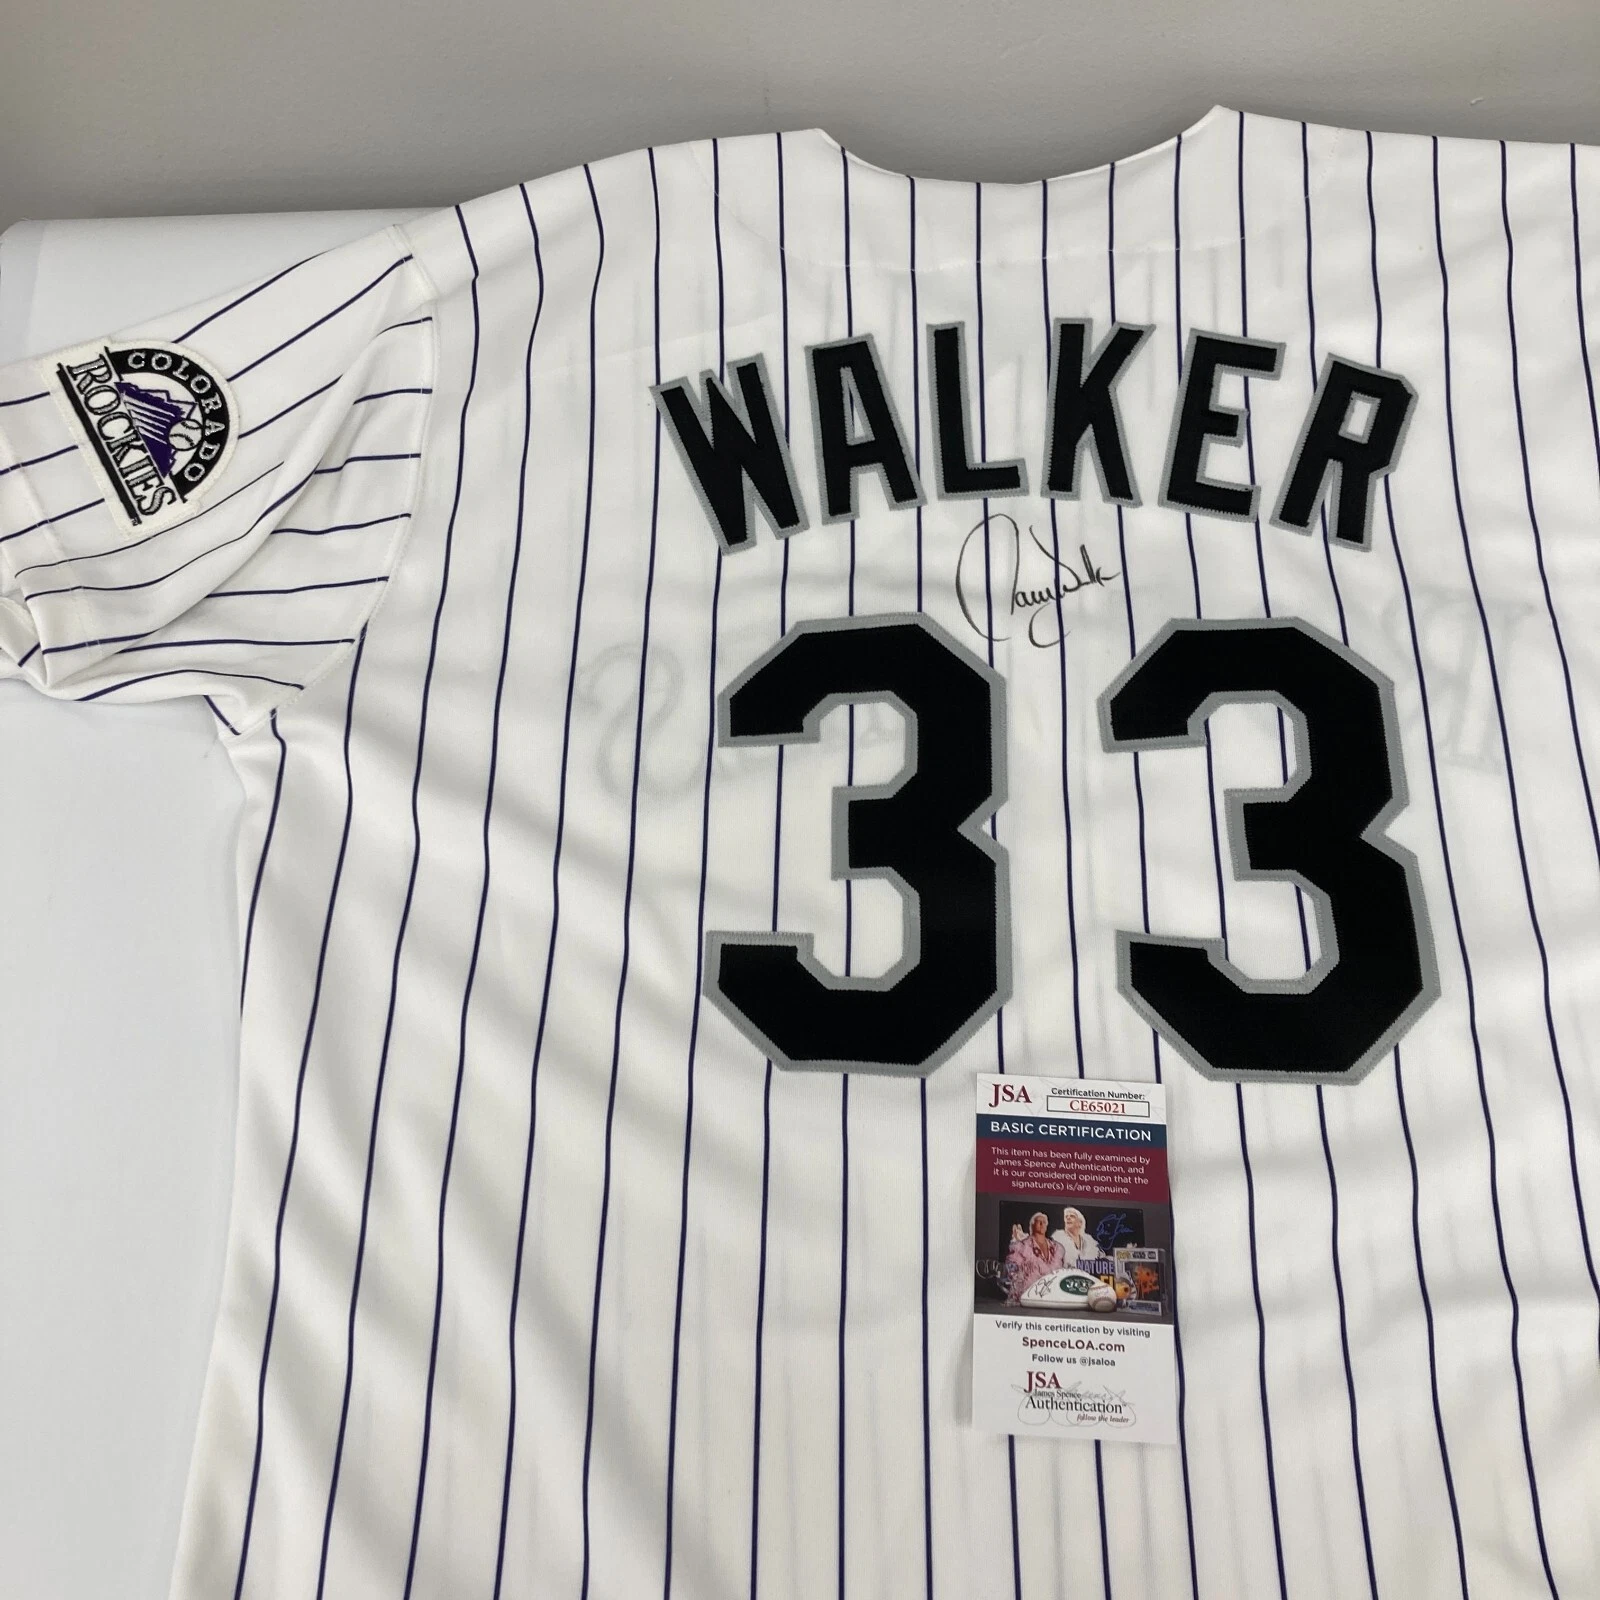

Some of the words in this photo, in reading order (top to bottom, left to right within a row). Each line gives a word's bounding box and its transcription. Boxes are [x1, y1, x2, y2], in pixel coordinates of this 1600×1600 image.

[127, 351, 226, 483] COLORADO
[67, 353, 178, 516] ROCKIES
[650, 317, 1419, 553] WALKER
[704, 612, 1441, 1084] 33
[989, 1084, 1032, 1108] JSA
[1051, 1087, 1105, 1098] Certification
[1107, 1091, 1145, 1100] Number:
[1069, 1100, 1126, 1114] CE65021
[991, 1121, 1034, 1134] BASIC
[1039, 1124, 1151, 1141] CERTIFICATION
[991, 1147, 1009, 1156] This
[1011, 1148, 1030, 1157] item
[1033, 1149, 1048, 1157] has
[1050, 1150, 1072, 1158] been
[1074, 1151, 1093, 1161] fully
[1095, 1152, 1137, 1162] examined
[1140, 1156, 1150, 1165] by
[994, 1158, 1022, 1167] James
[1024, 1160, 1056, 1169] Spence
[1059, 1161, 1125, 1172] Authentication,
[1127, 1165, 1144, 1174] and
[1028, 1170, 1076, 1180] considered
[1079, 1174, 1112, 1184] opinion
[1114, 1175, 1133, 1183] that
[1134, 1176, 1149, 1184] the
[1011, 1180, 1064, 1190] signature(s)
[1066, 1182, 1092, 1192] is/are
[1094, 1184, 1130, 1195] genuine.
[1076, 1259, 1114, 1274] NATURE
[996, 1320, 1023, 1331] Verify
[1025, 1321, 1042, 1331] this
[1044, 1323, 1100, 1333] certification
[1103, 1326, 1115, 1336] by
[1117, 1326, 1150, 1338] visiting
[1022, 1336, 1125, 1353] SpenceLOA.com
[1032, 1354, 1064, 1363] Follow
[1079, 1357, 1116, 1366] @jsaloa
[1024, 1370, 1061, 1393] JSA
[1034, 1389, 1055, 1398] James
[1057, 1390, 1081, 1400] Spence
[1076, 1414, 1097, 1423] follow
[1098, 1415, 1108, 1423] the
[1110, 1415, 1130, 1424] leader
